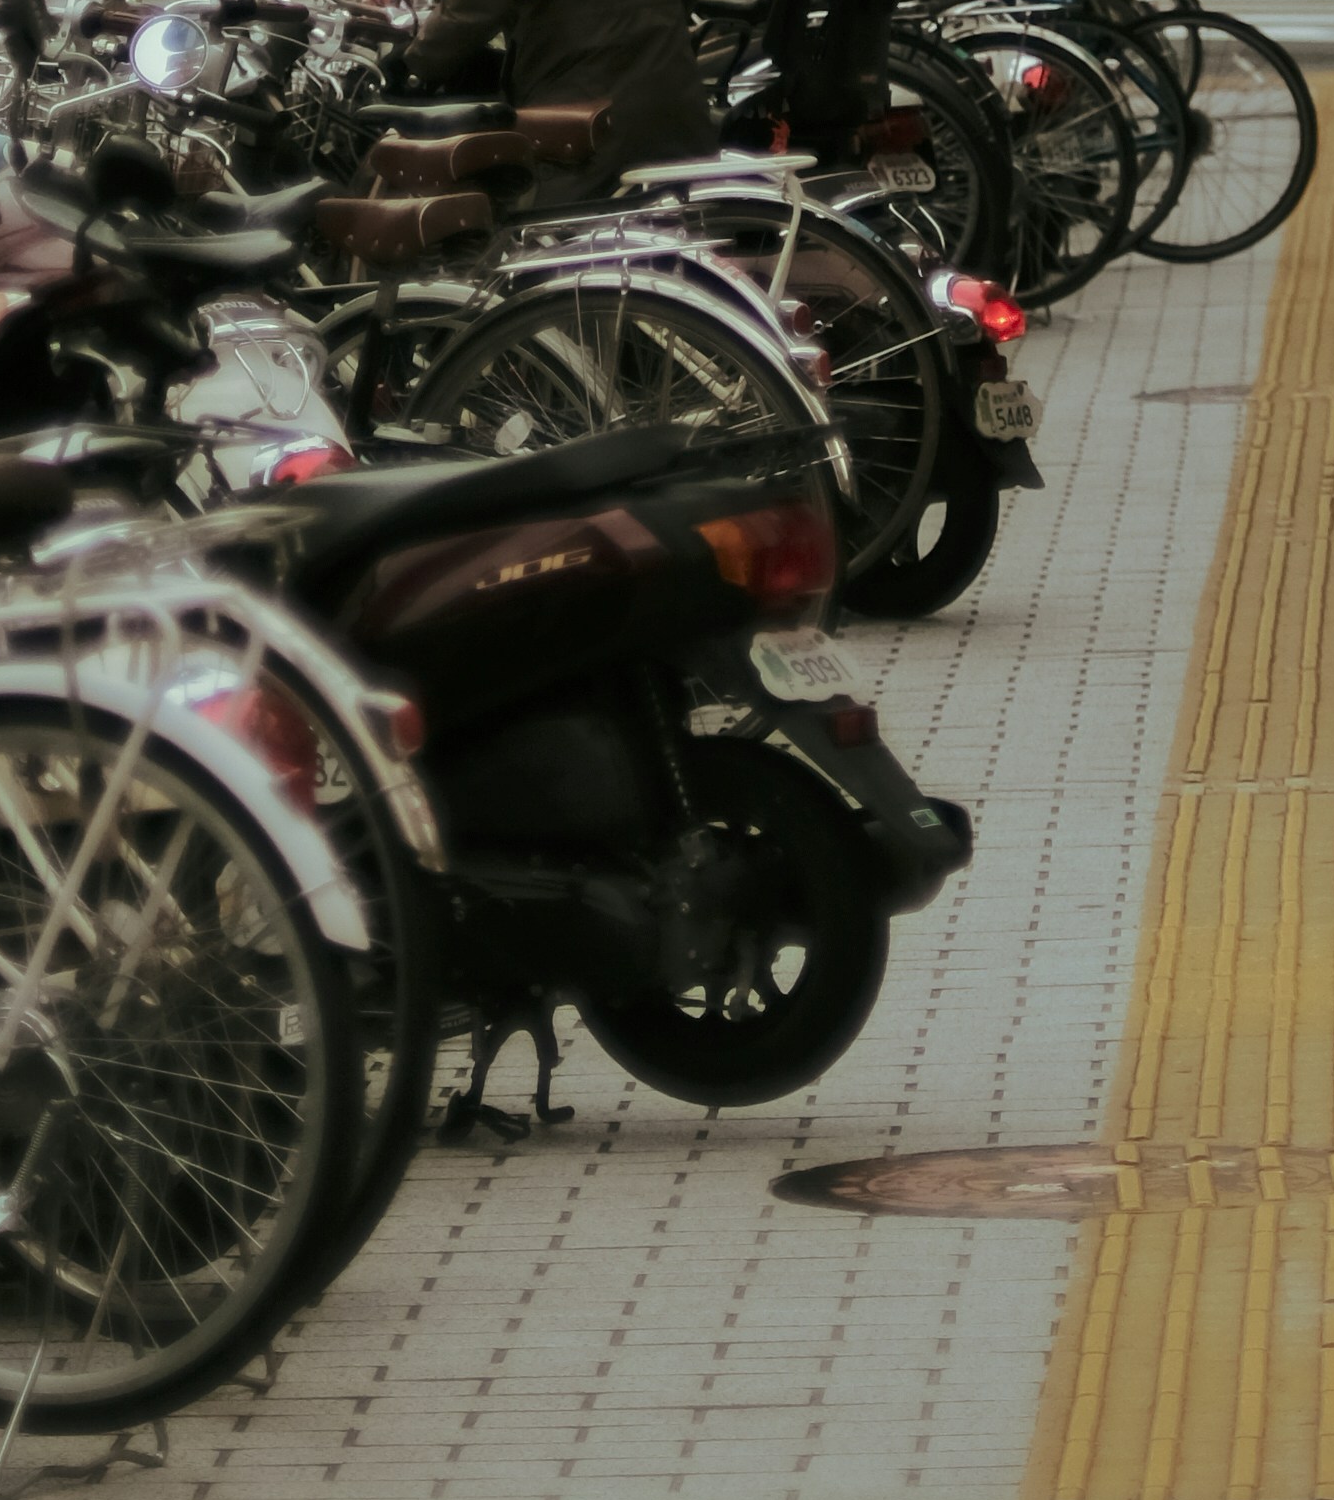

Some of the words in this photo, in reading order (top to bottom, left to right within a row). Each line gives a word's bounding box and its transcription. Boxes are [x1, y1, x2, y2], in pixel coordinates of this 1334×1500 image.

[893, 168, 932, 186] 6323
[197, 301, 264, 316] HONDA
[790, 653, 854, 687] 9091
